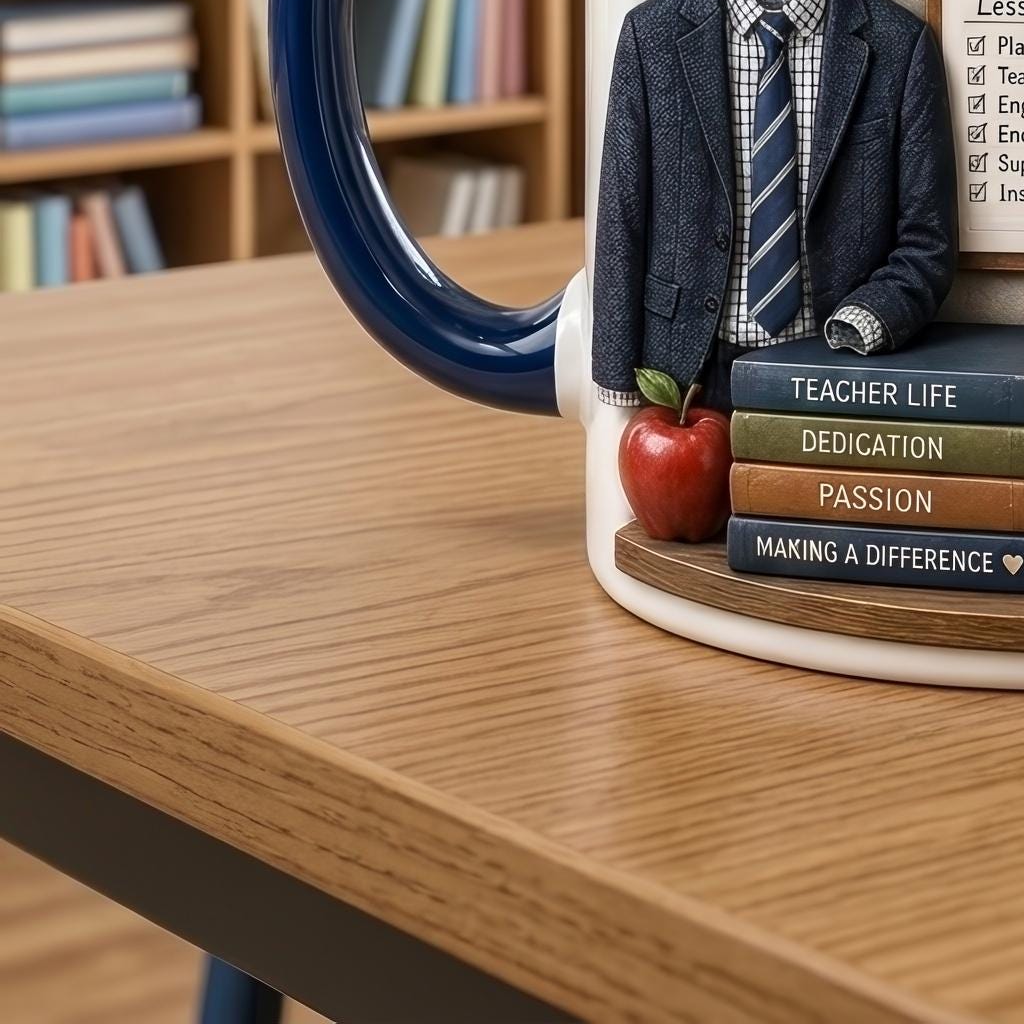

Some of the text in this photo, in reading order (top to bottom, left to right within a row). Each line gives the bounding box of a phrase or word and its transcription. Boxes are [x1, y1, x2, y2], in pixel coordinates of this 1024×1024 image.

[791, 378, 958, 409] TEACHER LIFE
[801, 429, 944, 460] DEDICATION
[818, 483, 933, 514] PASSION
[756, 536, 994, 574] MAKING A DIFFERENCE
